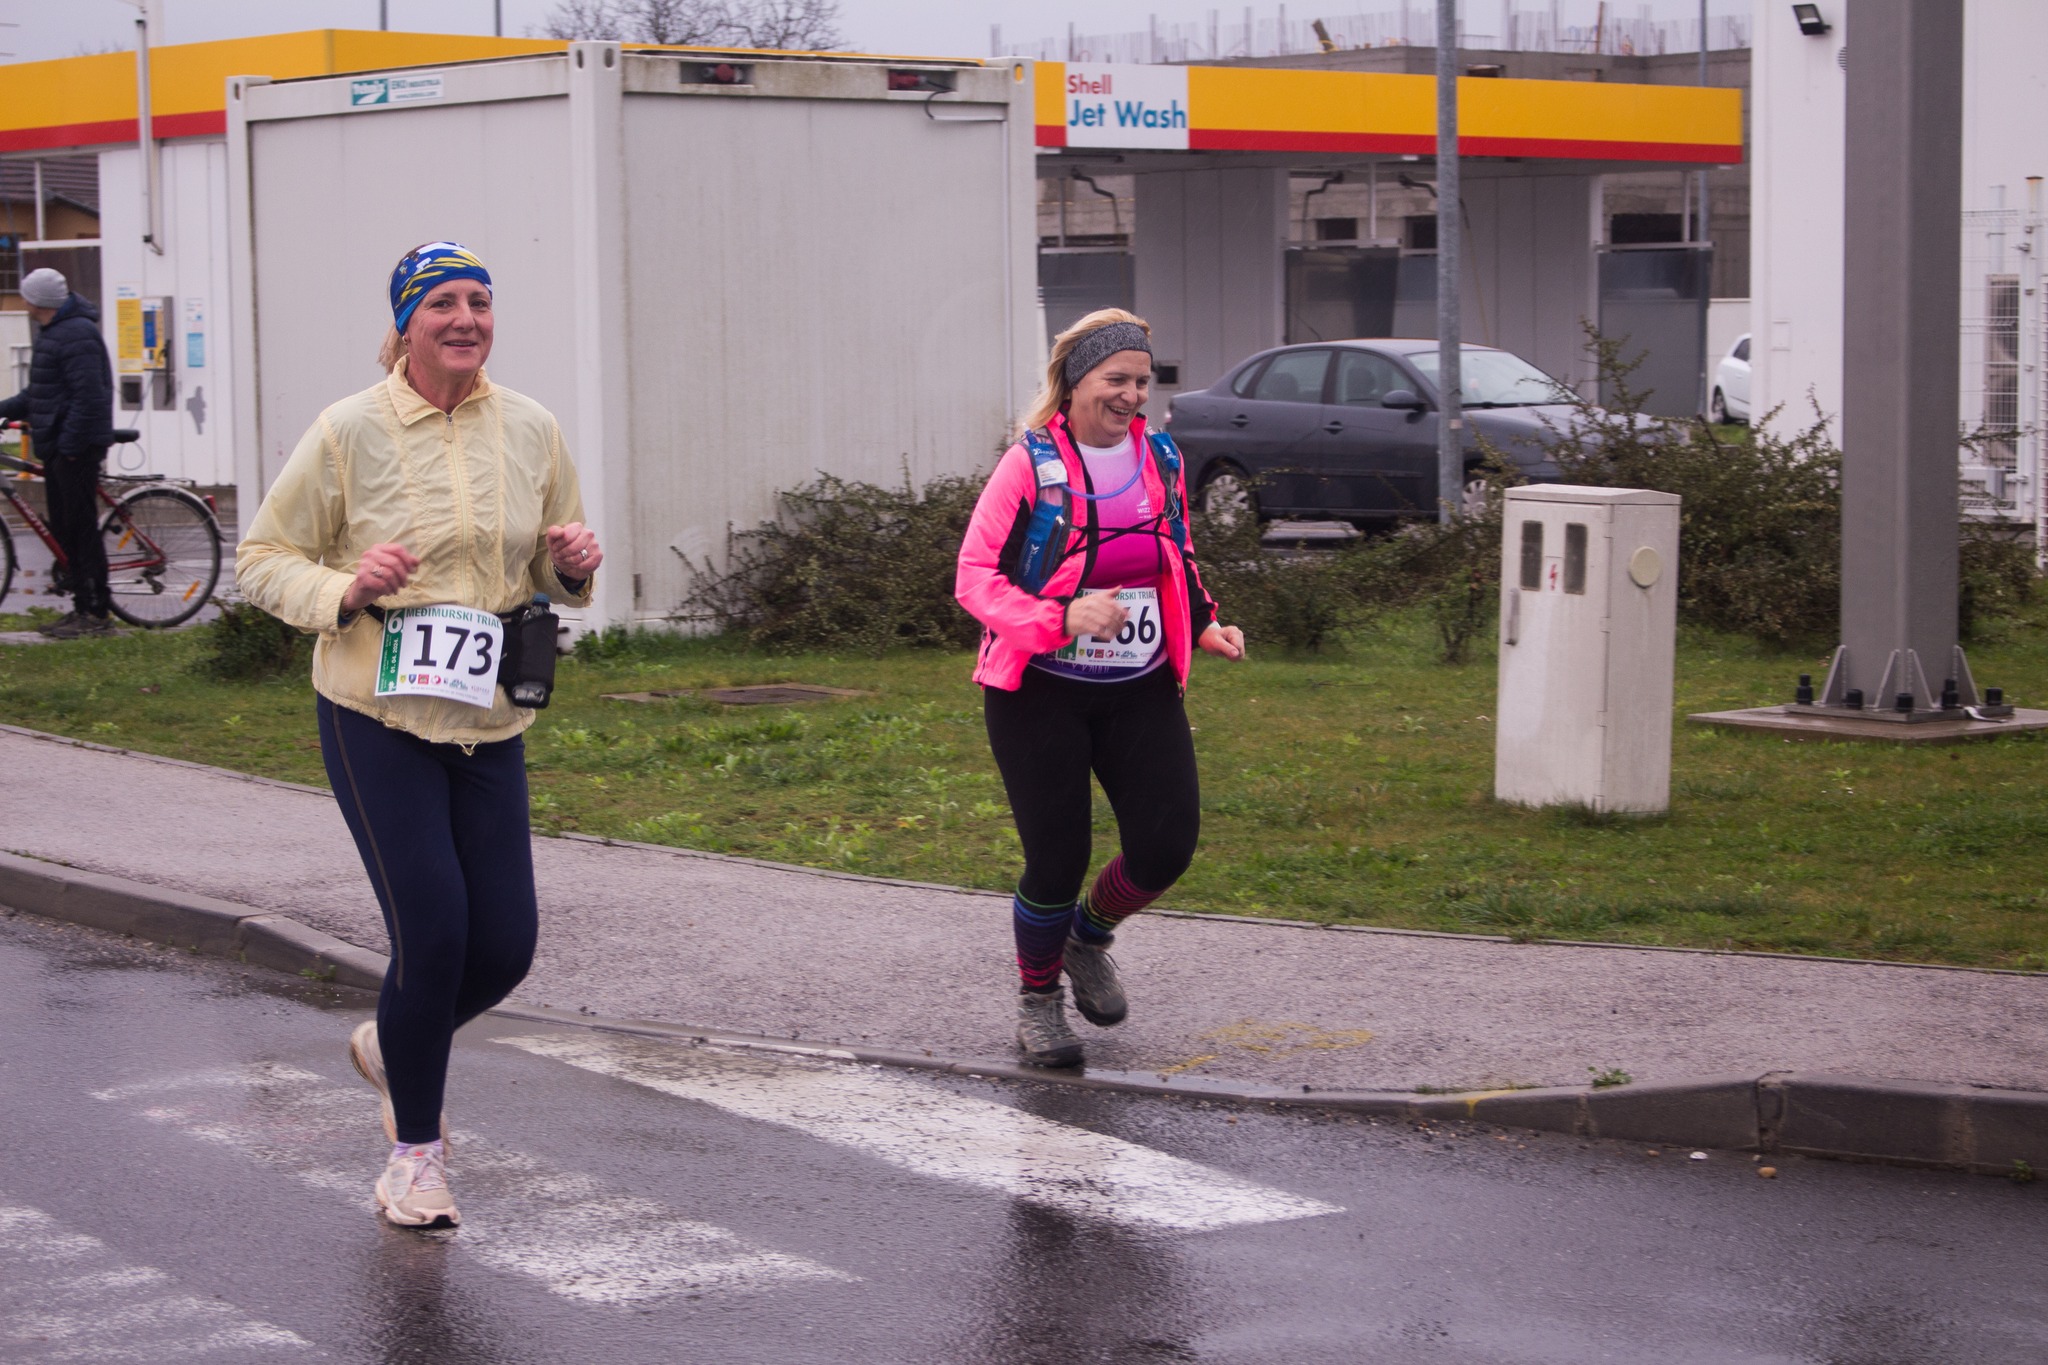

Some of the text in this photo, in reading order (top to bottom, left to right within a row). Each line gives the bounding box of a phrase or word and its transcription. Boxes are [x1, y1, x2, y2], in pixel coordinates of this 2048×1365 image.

[1067, 73, 1112, 95] Shell
[1068, 99, 1187, 129] Jet Wash
[1091, 605, 1156, 645] 66
[413, 623, 494, 676] 173
